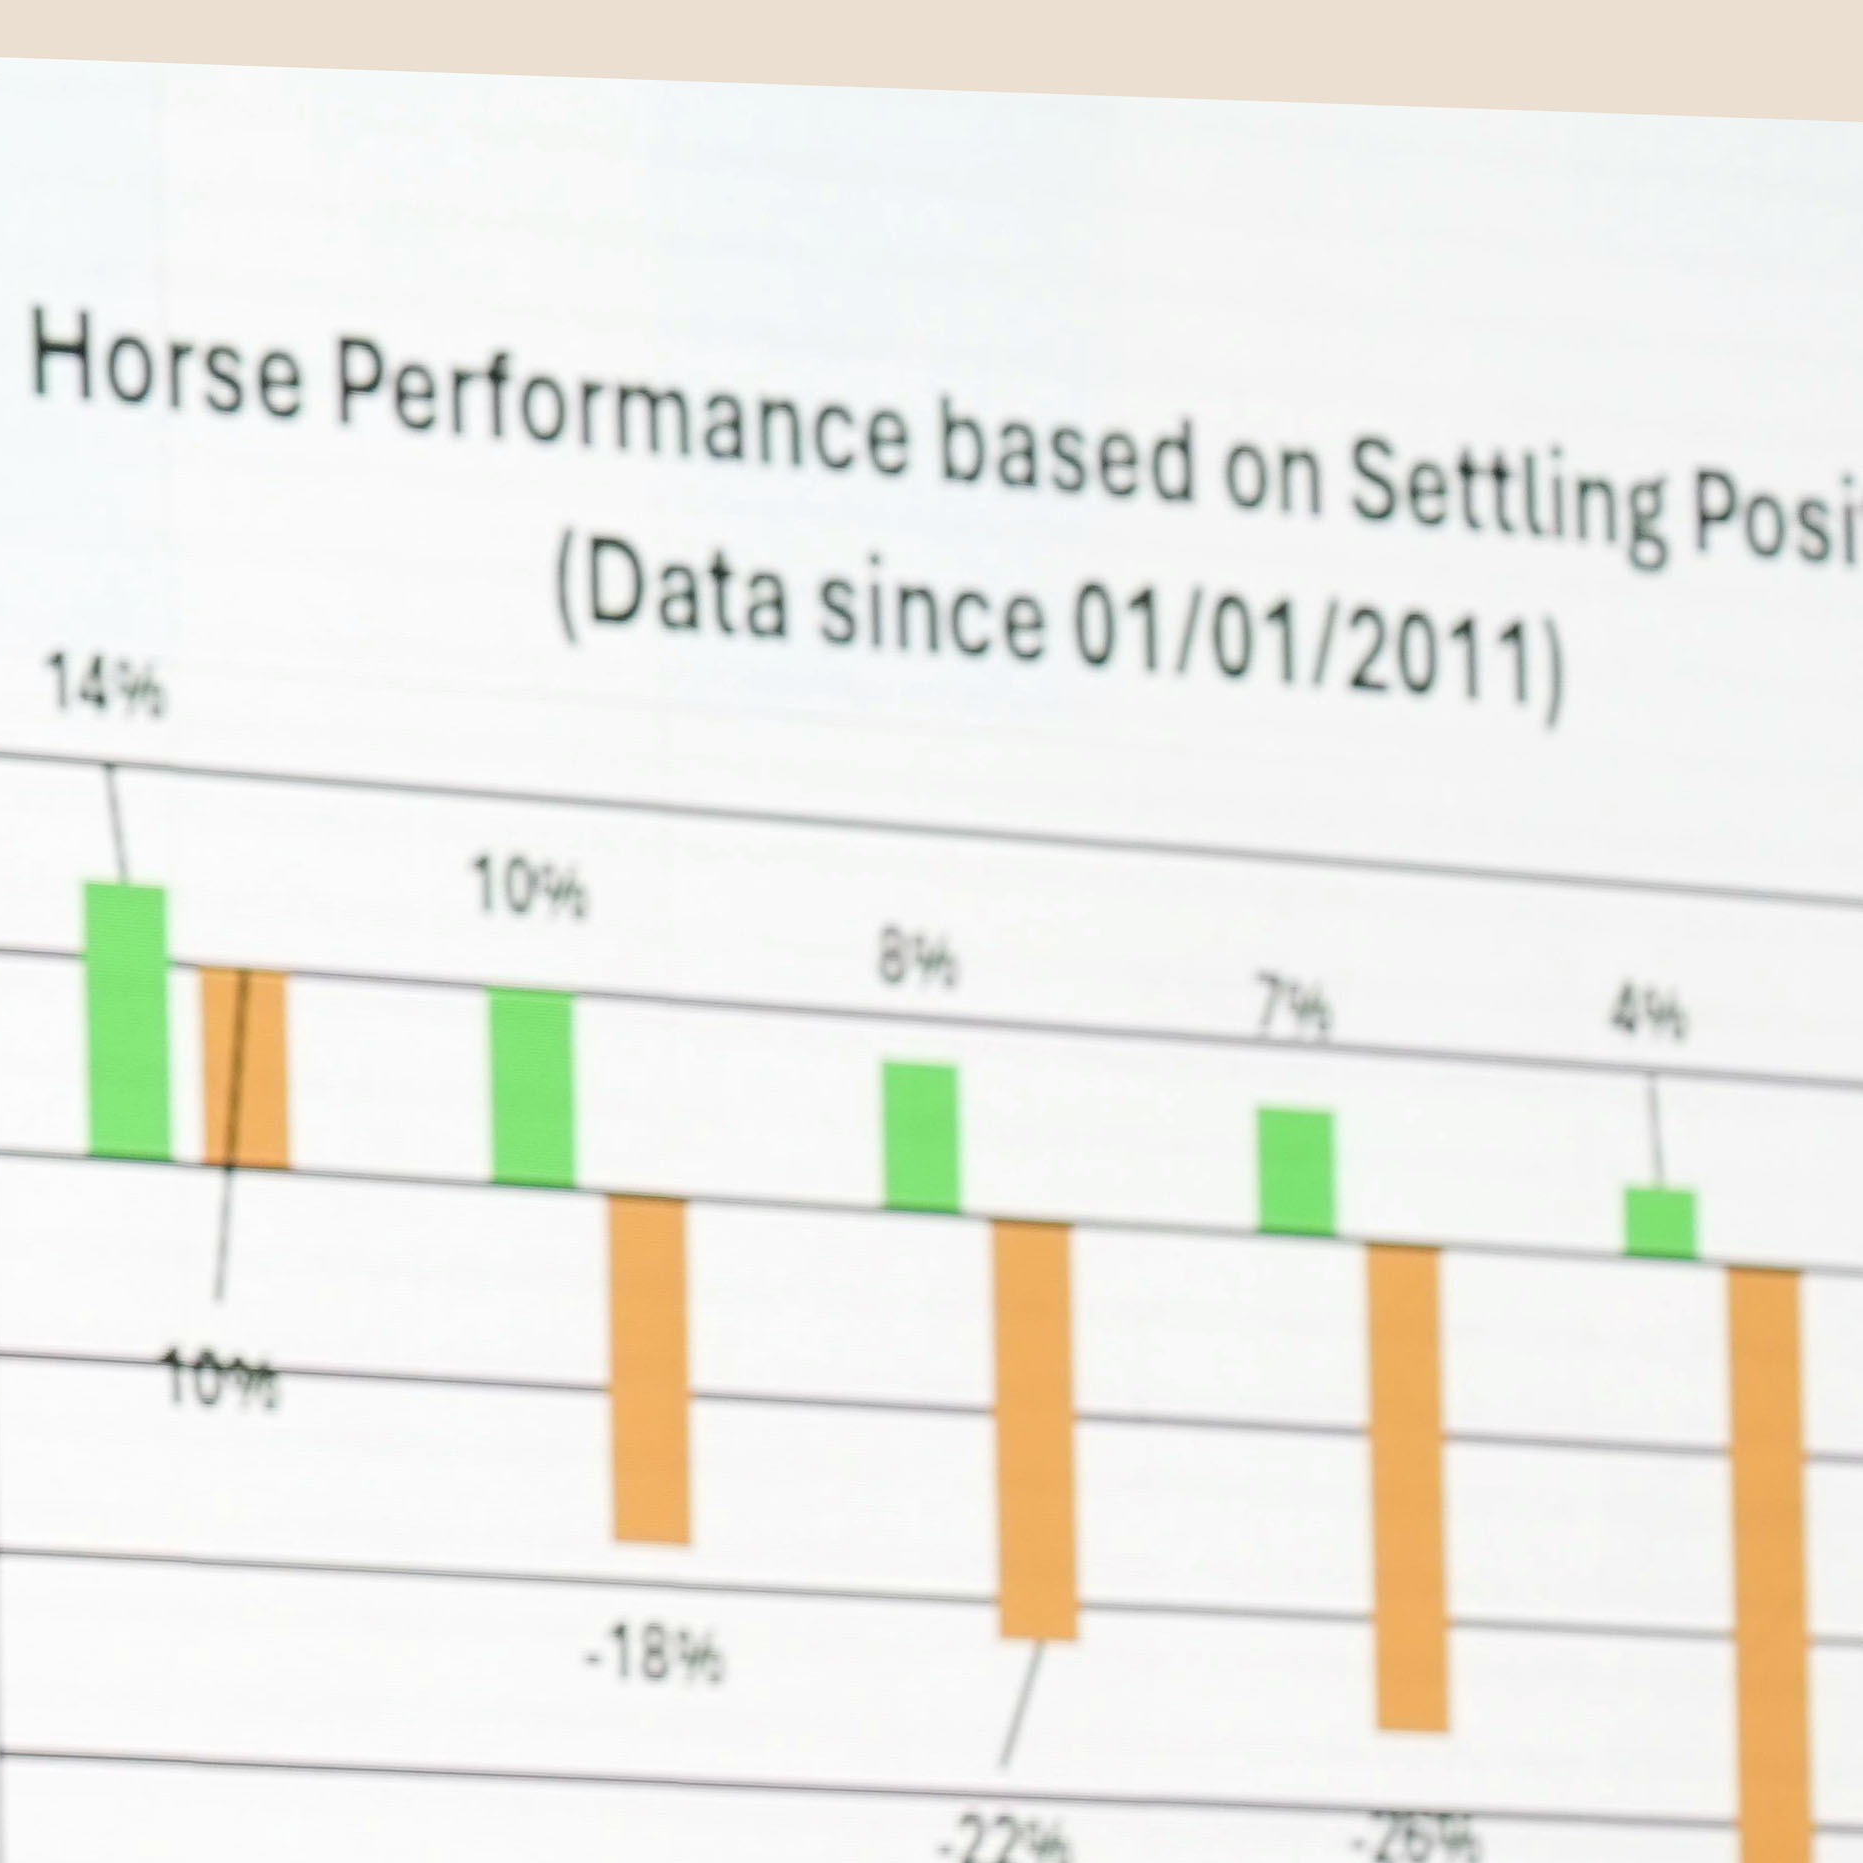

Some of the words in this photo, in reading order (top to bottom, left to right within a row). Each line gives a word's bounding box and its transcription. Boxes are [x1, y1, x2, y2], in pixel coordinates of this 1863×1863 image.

[32, 306, 302, 419] Horse
[337, 335, 910, 477] Performance
[940, 397, 1194, 503] based
[1224, 442, 1321, 515] on
[1351, 435, 1669, 573] Settling
[1695, 467, 1863, 565] Posi
[557, 530, 788, 641] (Data
[819, 554, 1046, 663] since
[1073, 580, 1563, 726] 01/01/2011)
[46, 651, 163, 717] 14%
[471, 853, 587, 920] 10%
[878, 924, 957, 988] 8%
[1257, 971, 1332, 1033] 7%
[1610, 982, 1686, 1040] 4%
[158, 1347, 282, 1410] 10%
[586, 1621, 723, 1684] -18%
